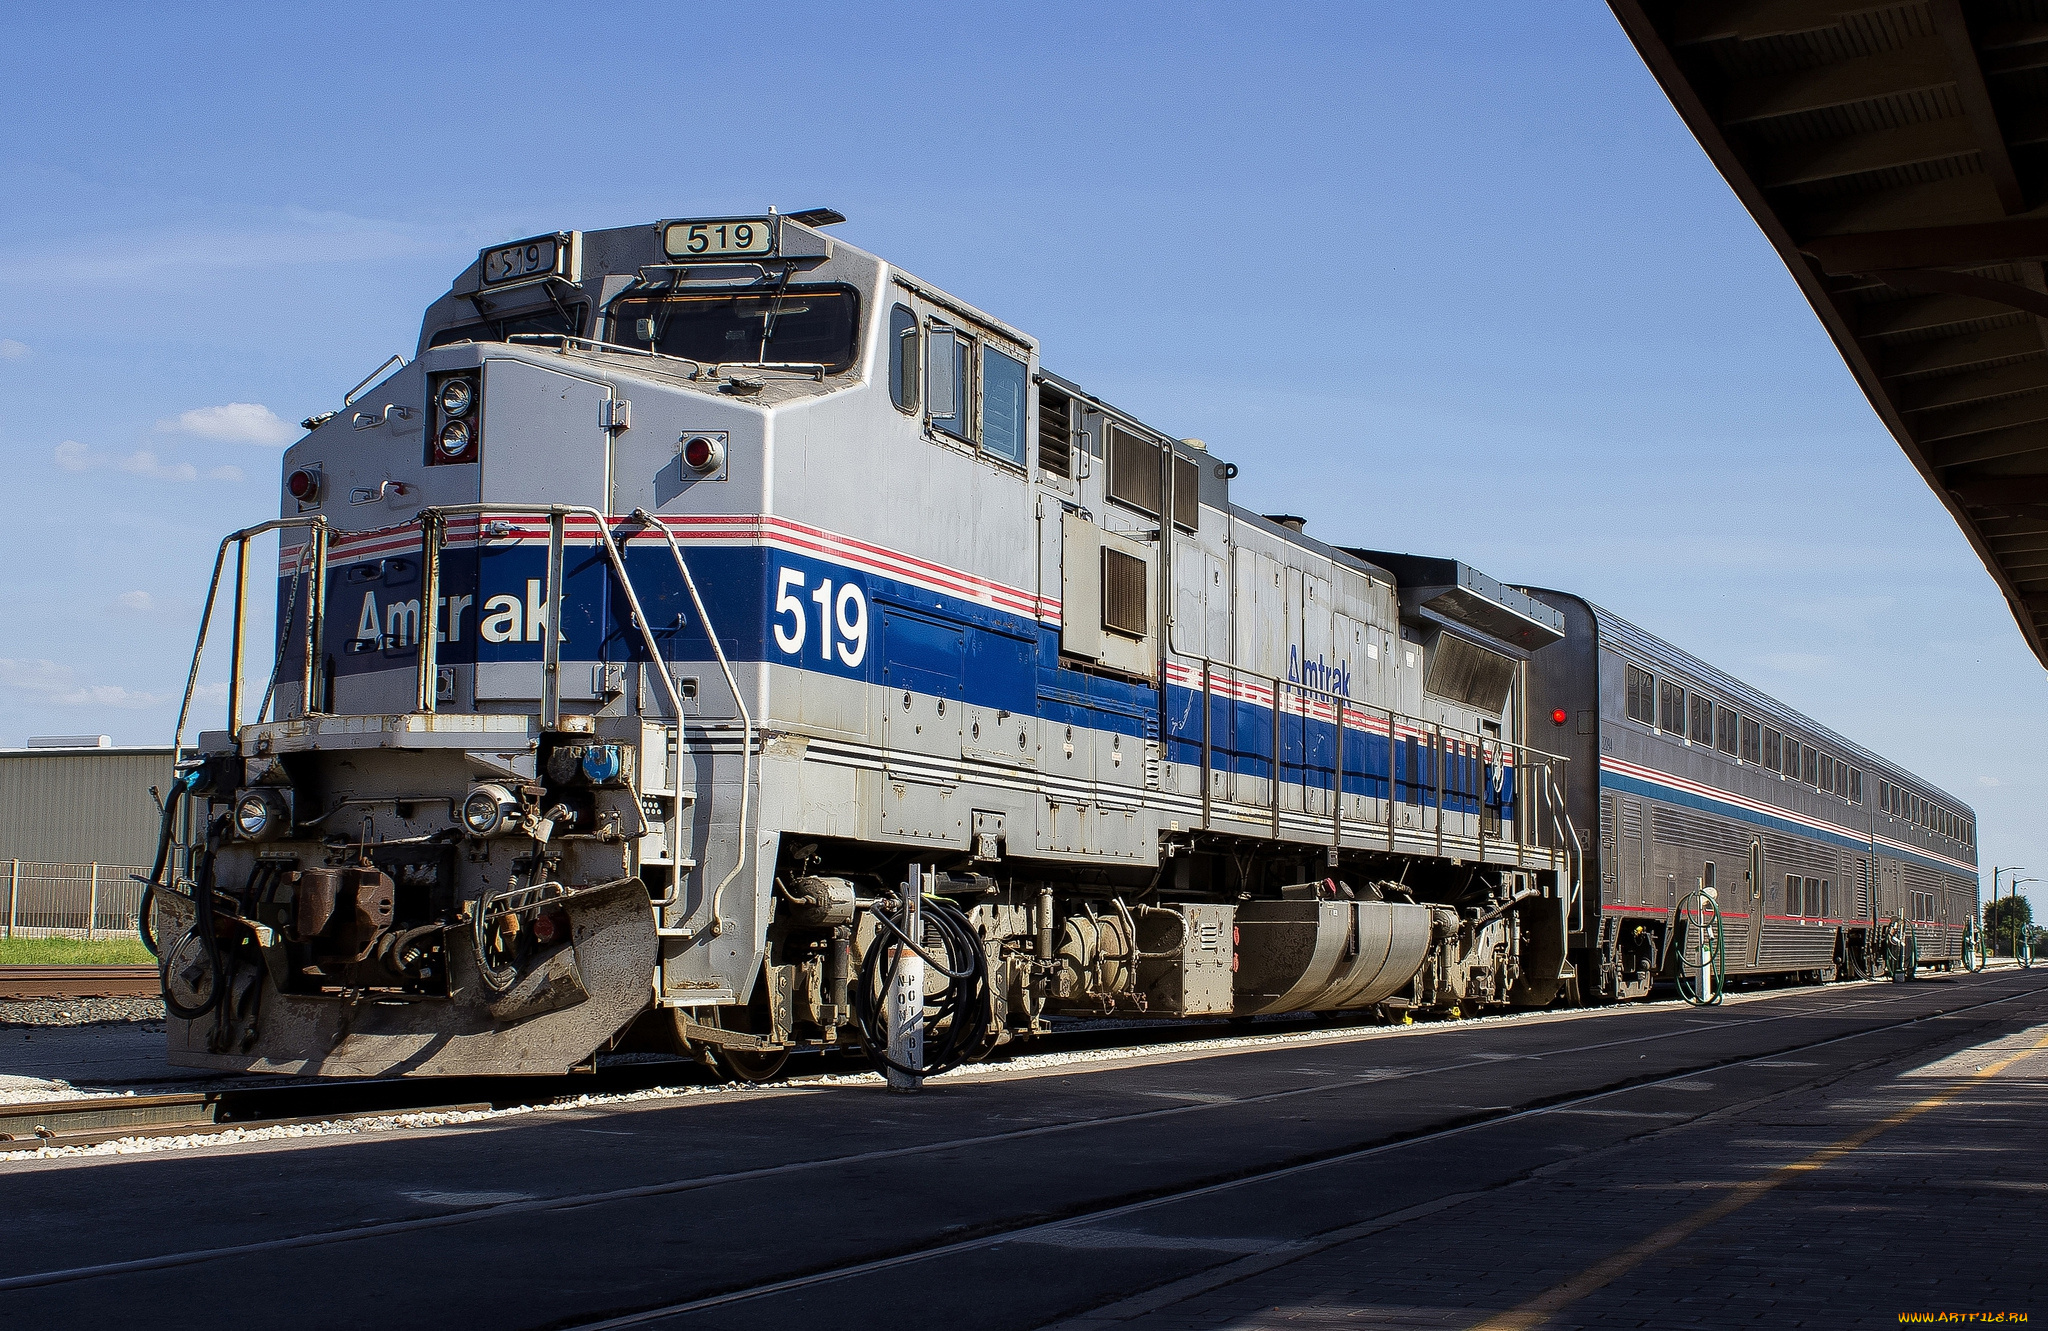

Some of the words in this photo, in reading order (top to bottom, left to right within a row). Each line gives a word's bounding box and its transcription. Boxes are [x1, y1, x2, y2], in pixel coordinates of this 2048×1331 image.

[500, 244, 540, 278] 519
[687, 224, 754, 253] 519
[354, 578, 570, 652] Amrak
[773, 565, 868, 668] 519
[1286, 644, 1352, 709] Amtrak
